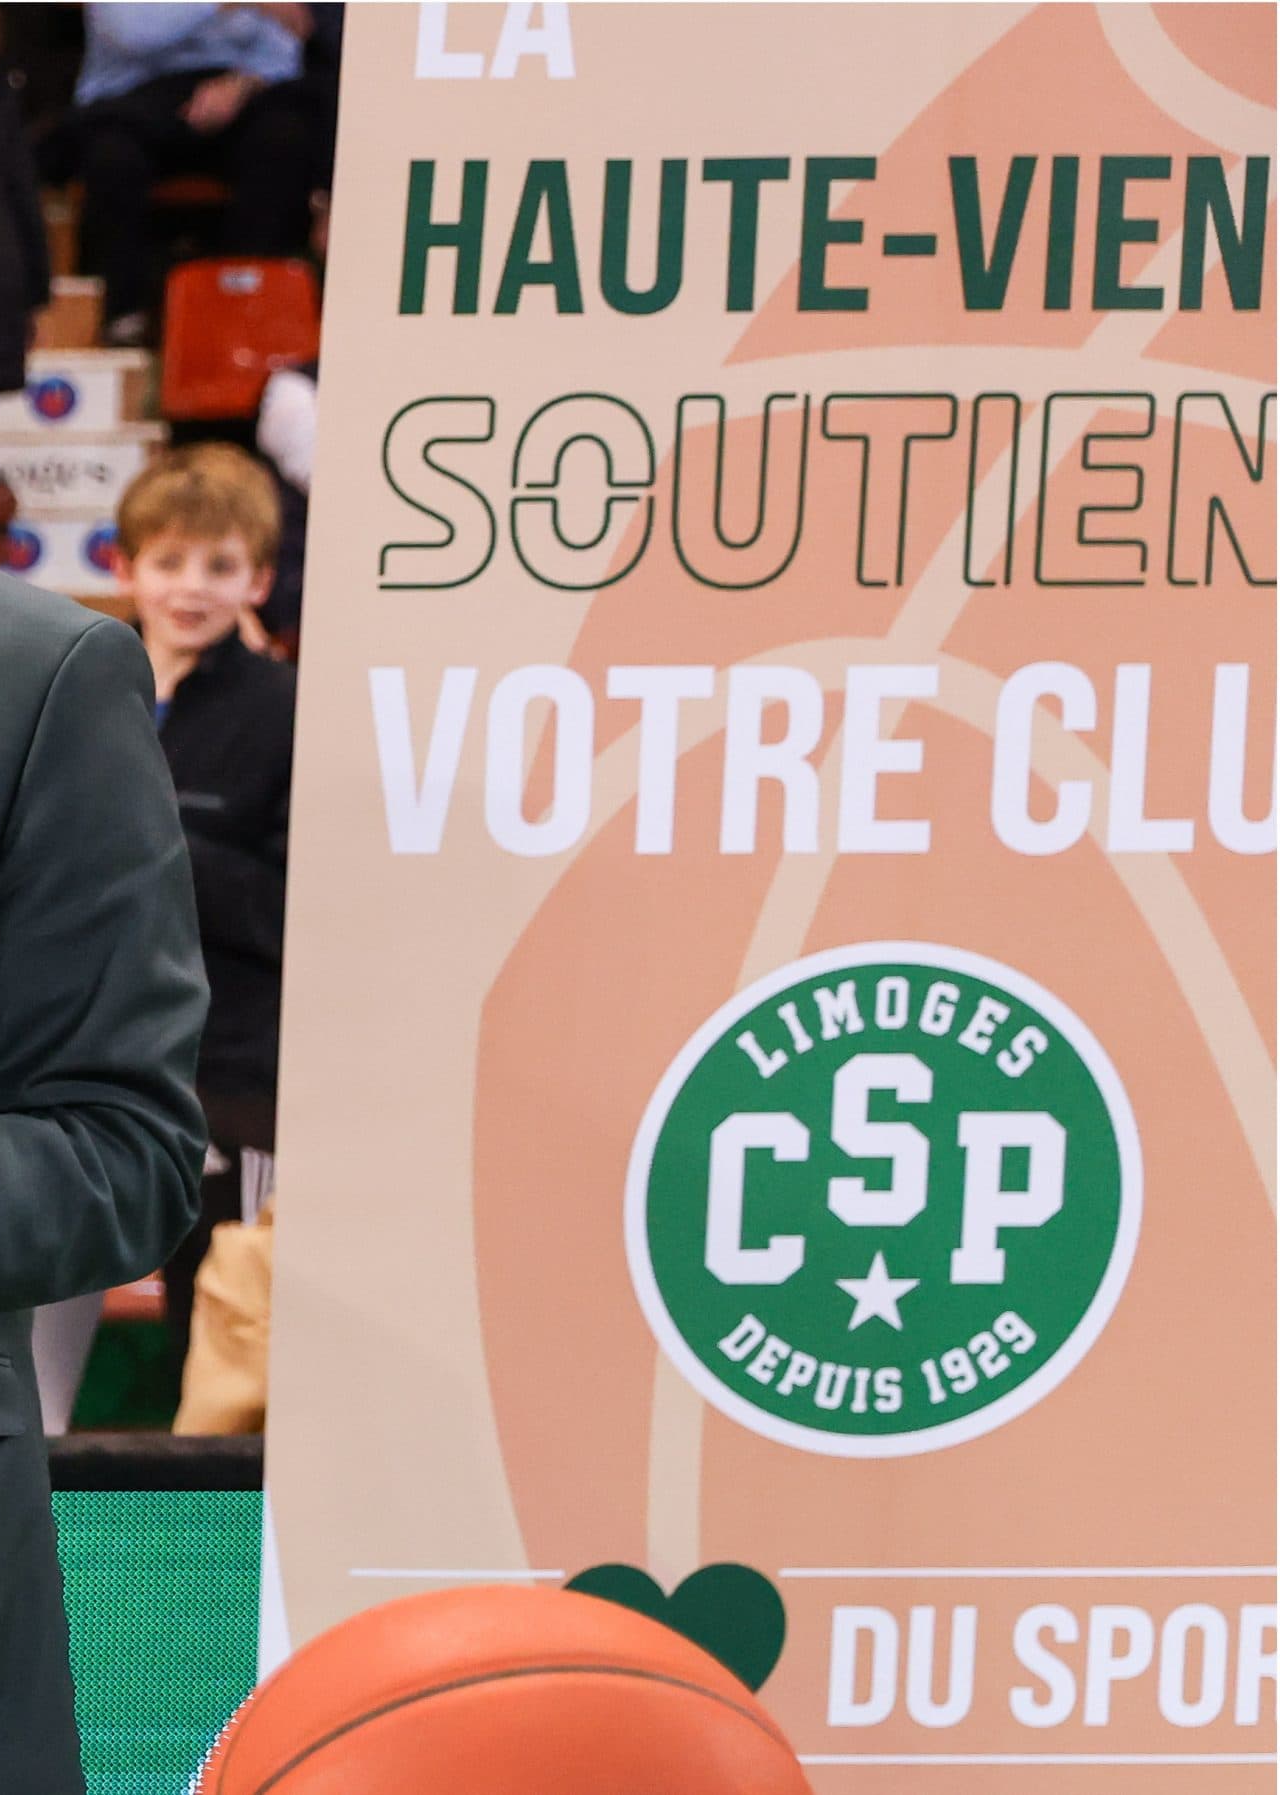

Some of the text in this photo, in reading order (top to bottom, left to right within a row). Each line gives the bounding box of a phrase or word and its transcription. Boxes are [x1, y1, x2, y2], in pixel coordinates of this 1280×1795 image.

[415, 2, 576, 79] LA
[397, 155, 1270, 316] HAUTE-VIEN
[377, 391, 1277, 590] SOUTIEN
[367, 660, 1277, 858] VOTRE CLU
[736, 975, 1049, 1079] LIMOGES
[704, 1052, 1067, 1285] CSP
[716, 1310, 1038, 1413] DEPUIS 1929
[827, 1602, 1277, 1729] DU SPOR
